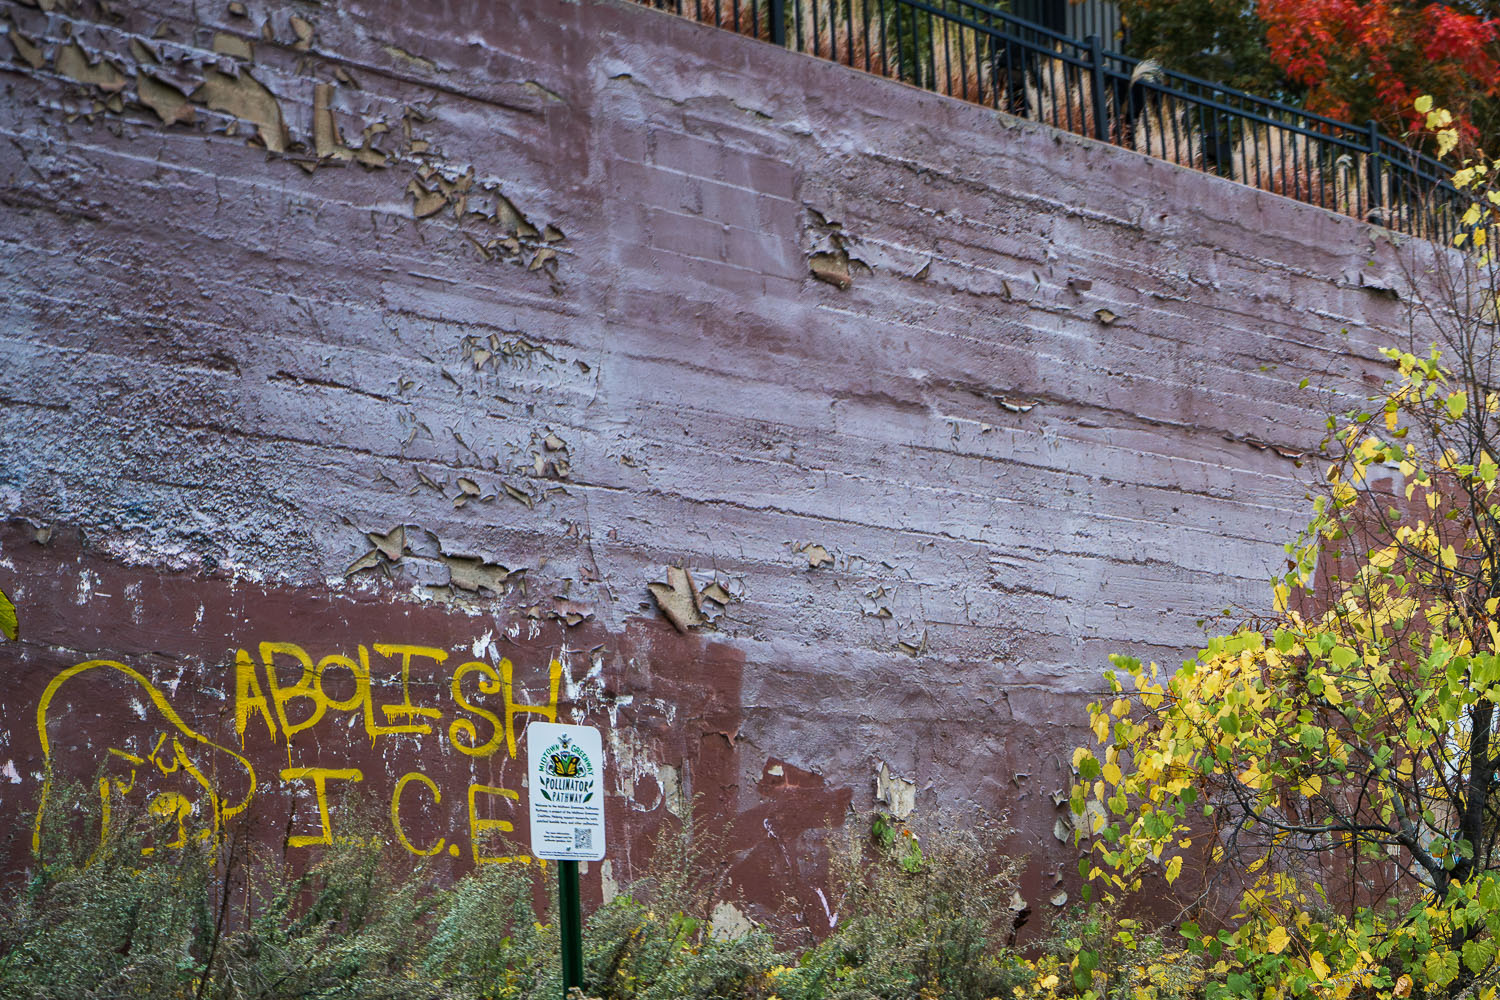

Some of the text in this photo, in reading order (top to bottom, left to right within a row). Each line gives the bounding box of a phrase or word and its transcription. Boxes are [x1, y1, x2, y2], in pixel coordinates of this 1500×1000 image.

[235, 641, 562, 759] ABOLISH
[538, 743, 594, 776] MIDTOWN GREENWAY
[545, 777, 589, 793] POLLINATOR
[552, 791, 583, 804] PATHWAY
